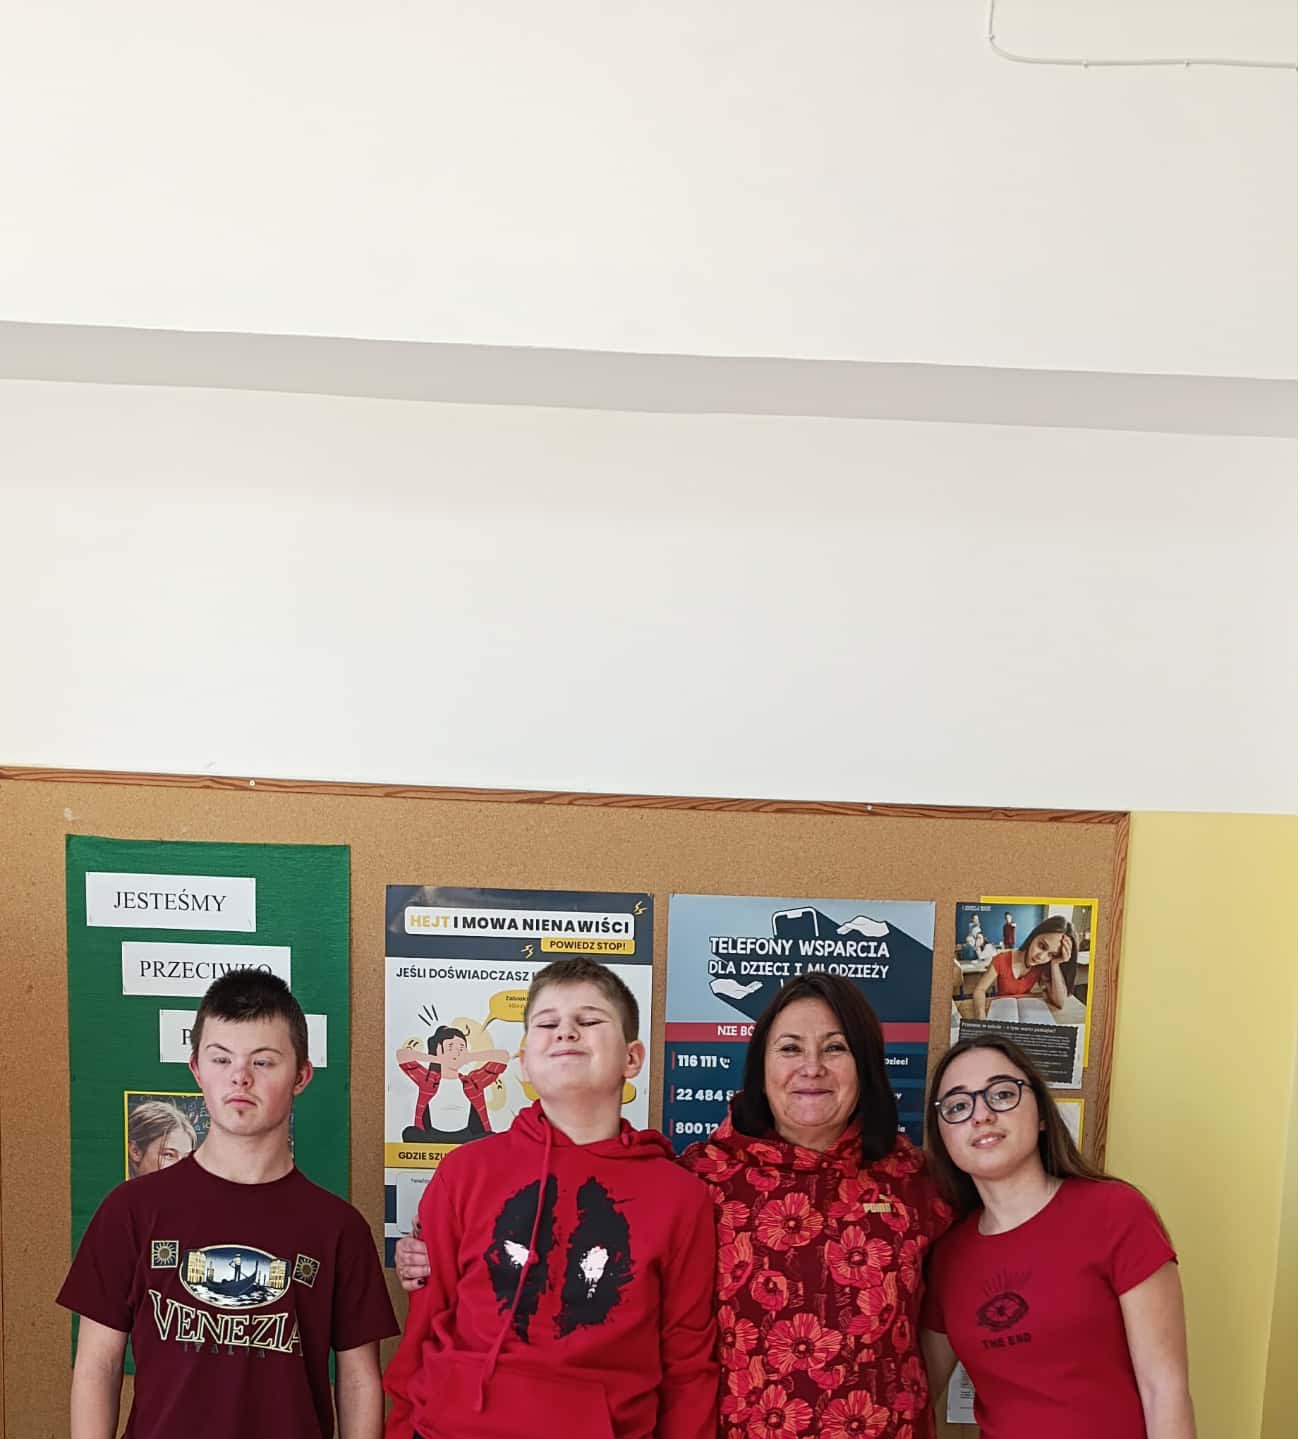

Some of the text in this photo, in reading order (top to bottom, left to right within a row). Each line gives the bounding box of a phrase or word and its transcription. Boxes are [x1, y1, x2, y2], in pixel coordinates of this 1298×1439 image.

[113, 888, 227, 912] JESTEŚMY
[409, 915, 629, 933] HEJT I MOWA NIENAWIŚCI
[550, 940, 626, 951] POWIEDZ STOP!
[710, 937, 890, 957] TELEFONY WSPARCIA
[395, 964, 426, 979] JEŚLI
[429, 966, 529, 981] DOŚWIADCZASZ
[709, 960, 736, 974] DLA
[741, 961, 790, 976] DZIECI
[793, 963, 803, 976] I
[717, 1025, 737, 1036] NIE
[677, 1054, 718, 1068] 116 111
[676, 1089, 693, 1101] 22
[695, 1089, 723, 1101] 484
[675, 1122, 703, 1134] 800
[398, 1151, 426, 1161] GDZIE
[148, 1289, 303, 1357] VENEZIA
